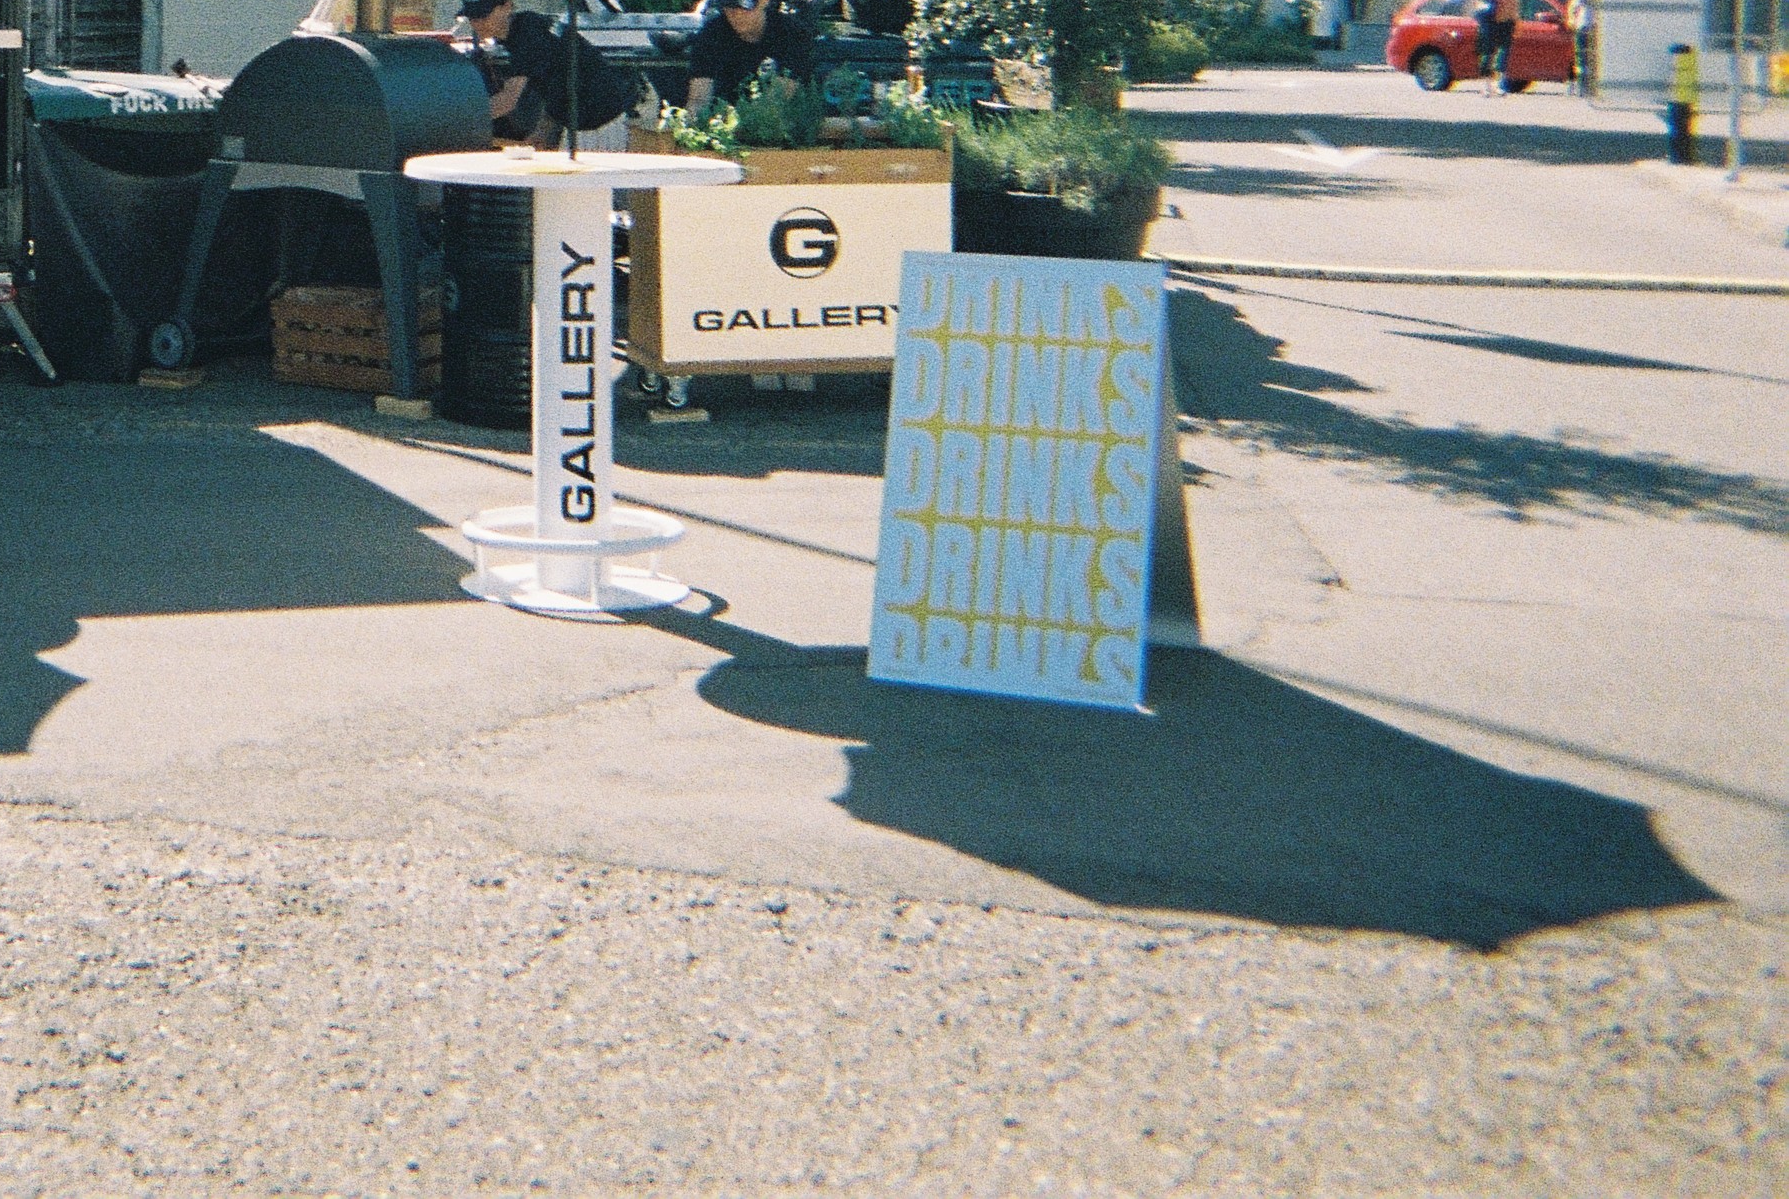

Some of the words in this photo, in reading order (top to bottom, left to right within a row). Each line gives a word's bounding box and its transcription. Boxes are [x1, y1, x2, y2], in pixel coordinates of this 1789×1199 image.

[769, 217, 839, 269] G
[693, 304, 899, 332] GALLER
[561, 240, 596, 524] GALLERY
[901, 338, 1153, 437] DRINKS
[895, 429, 1149, 532] DRINKS
[888, 521, 1143, 628] DRINKS
